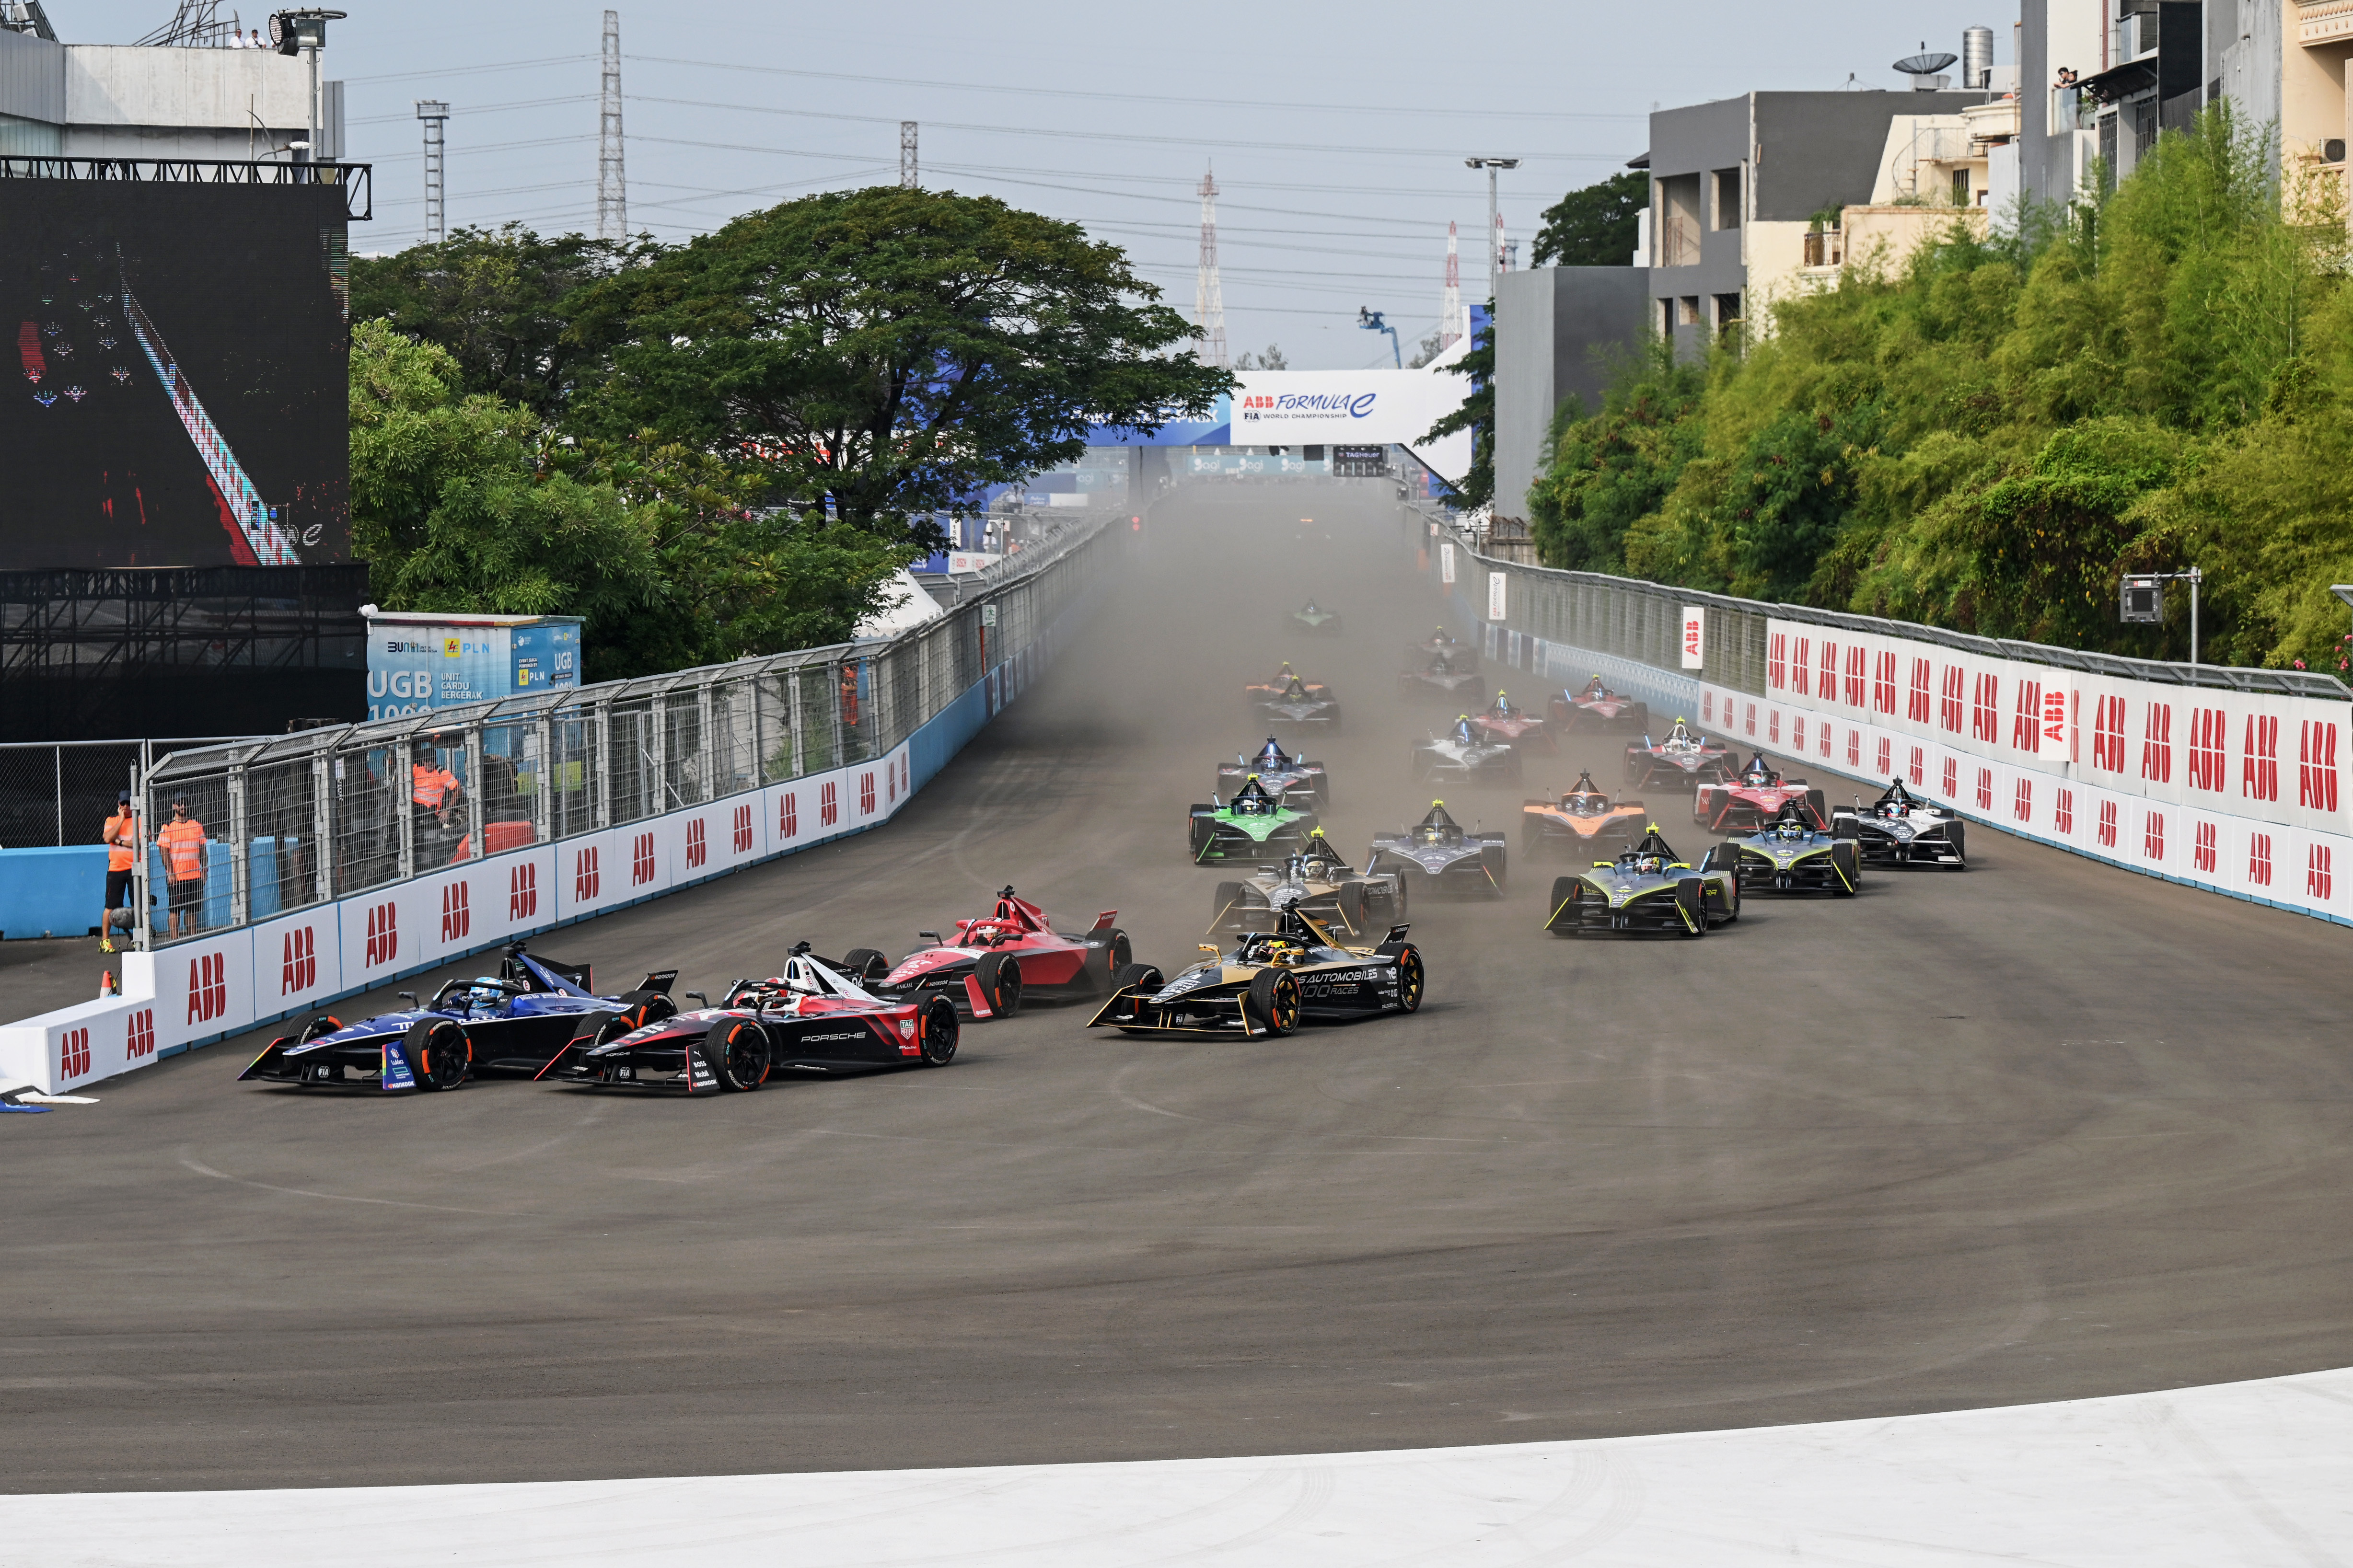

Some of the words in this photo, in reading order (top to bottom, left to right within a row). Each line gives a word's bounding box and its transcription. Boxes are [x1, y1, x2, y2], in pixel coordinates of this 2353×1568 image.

[1243, 396, 1274, 408] ABB
[1275, 394, 1351, 410] FORMULA
[463, 643, 489, 653] PLN
[555, 652, 572, 670] UGB
[1685, 621, 1699, 656] ABB
[1769, 633, 1786, 690] ABB
[368, 670, 433, 699] UGB
[441, 673, 460, 681] UNIT
[530, 671, 545, 681] PLN
[1793, 637, 1810, 696] ABB
[1819, 642, 1837, 702] ABB
[1846, 646, 1866, 708] ABB
[1875, 651, 1897, 715] ABB
[1703, 691, 1711, 722] ABB
[1724, 696, 1732, 729] ABB
[1909, 658, 1931, 725] ABB
[1941, 665, 1964, 734] ABB
[1973, 673, 1998, 744] ABB
[1746, 703, 1755, 737] ABB
[1769, 709, 1779, 744] ABB
[1794, 716, 1804, 751] ABB
[1820, 722, 1831, 758] ABB
[2014, 680, 2040, 753] ABB
[2044, 692, 2065, 743] ABB
[2095, 695, 2126, 774] ABB
[1848, 729, 1859, 767] ABB
[1878, 737, 1890, 775] ABB
[1910, 746, 1923, 786] ABB
[2142, 703, 2171, 784] ABB
[2189, 708, 2226, 793] ABB
[2244, 714, 2278, 802] ABB
[2300, 720, 2338, 812] ABB
[861, 772, 875, 816] ABB
[1943, 756, 1957, 799] ABB
[1977, 767, 1992, 811] ABB
[2015, 777, 2032, 823] ABB
[780, 792, 797, 840] ABB
[821, 781, 837, 828] ABB
[2054, 788, 2073, 835] ABB
[2098, 800, 2117, 848] ABB
[686, 818, 706, 869] ABB
[734, 804, 753, 854] ABB
[2144, 810, 2164, 861] ABB
[2194, 820, 2216, 874] ABB
[576, 846, 599, 903] ABB
[633, 832, 655, 887] ABB
[2249, 832, 2272, 887] ABB
[2307, 843, 2331, 900] ABB
[442, 881, 469, 943] ABB
[510, 863, 536, 922] ABB
[366, 902, 397, 968] ABB
[282, 925, 315, 996] ABB
[575, 976, 581, 988] 7
[1306, 968, 1378, 983] AUTOMOBILES
[188, 952, 226, 1025] ABB
[1301, 985, 1331, 998] 100
[61, 1028, 90, 1081] ABB
[127, 1009, 154, 1061] ABB
[594, 1024, 606, 1046] ankook
[801, 1032, 866, 1042] PORSCHE
[901, 1028, 914, 1037] HEUER
[695, 1070, 709, 1078] Mobil
[696, 1079, 717, 1087] Hankook
